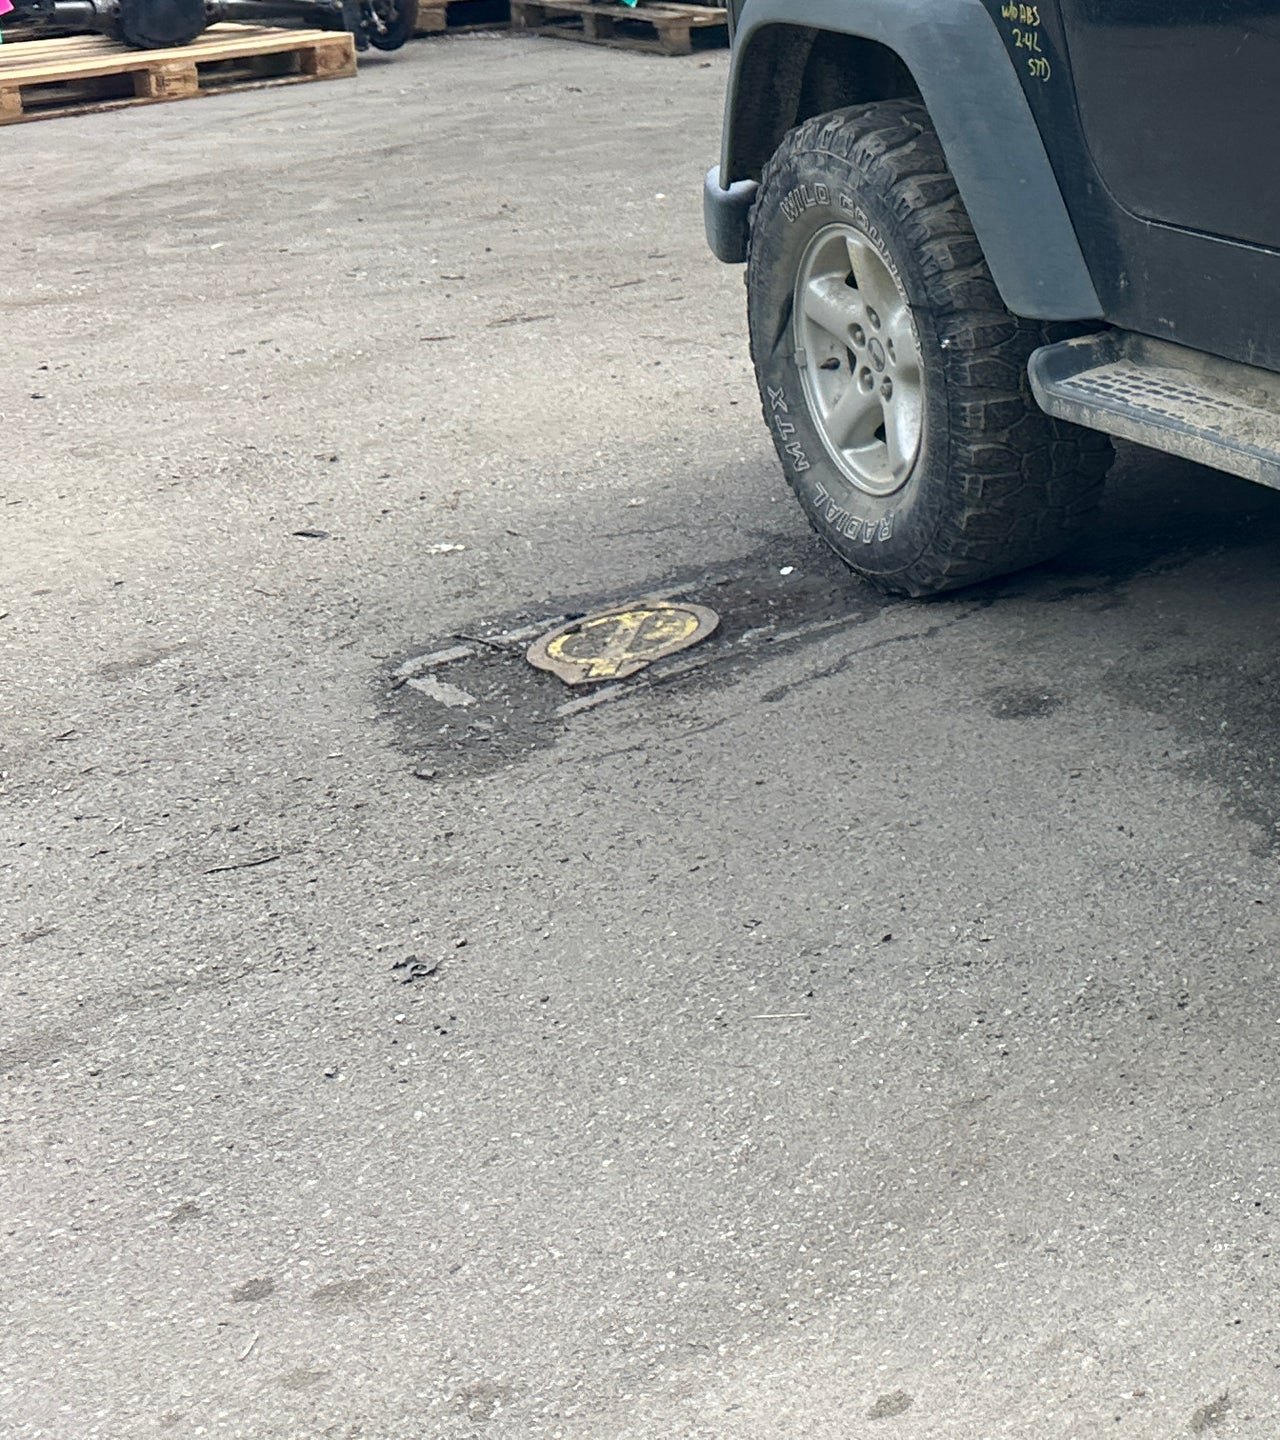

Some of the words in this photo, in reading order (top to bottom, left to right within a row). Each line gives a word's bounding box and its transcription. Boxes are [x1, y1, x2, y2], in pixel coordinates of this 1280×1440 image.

[780, 182, 831, 223] WILD
[767, 385, 811, 473] MTX
[813, 481, 895, 544] RADIAL
